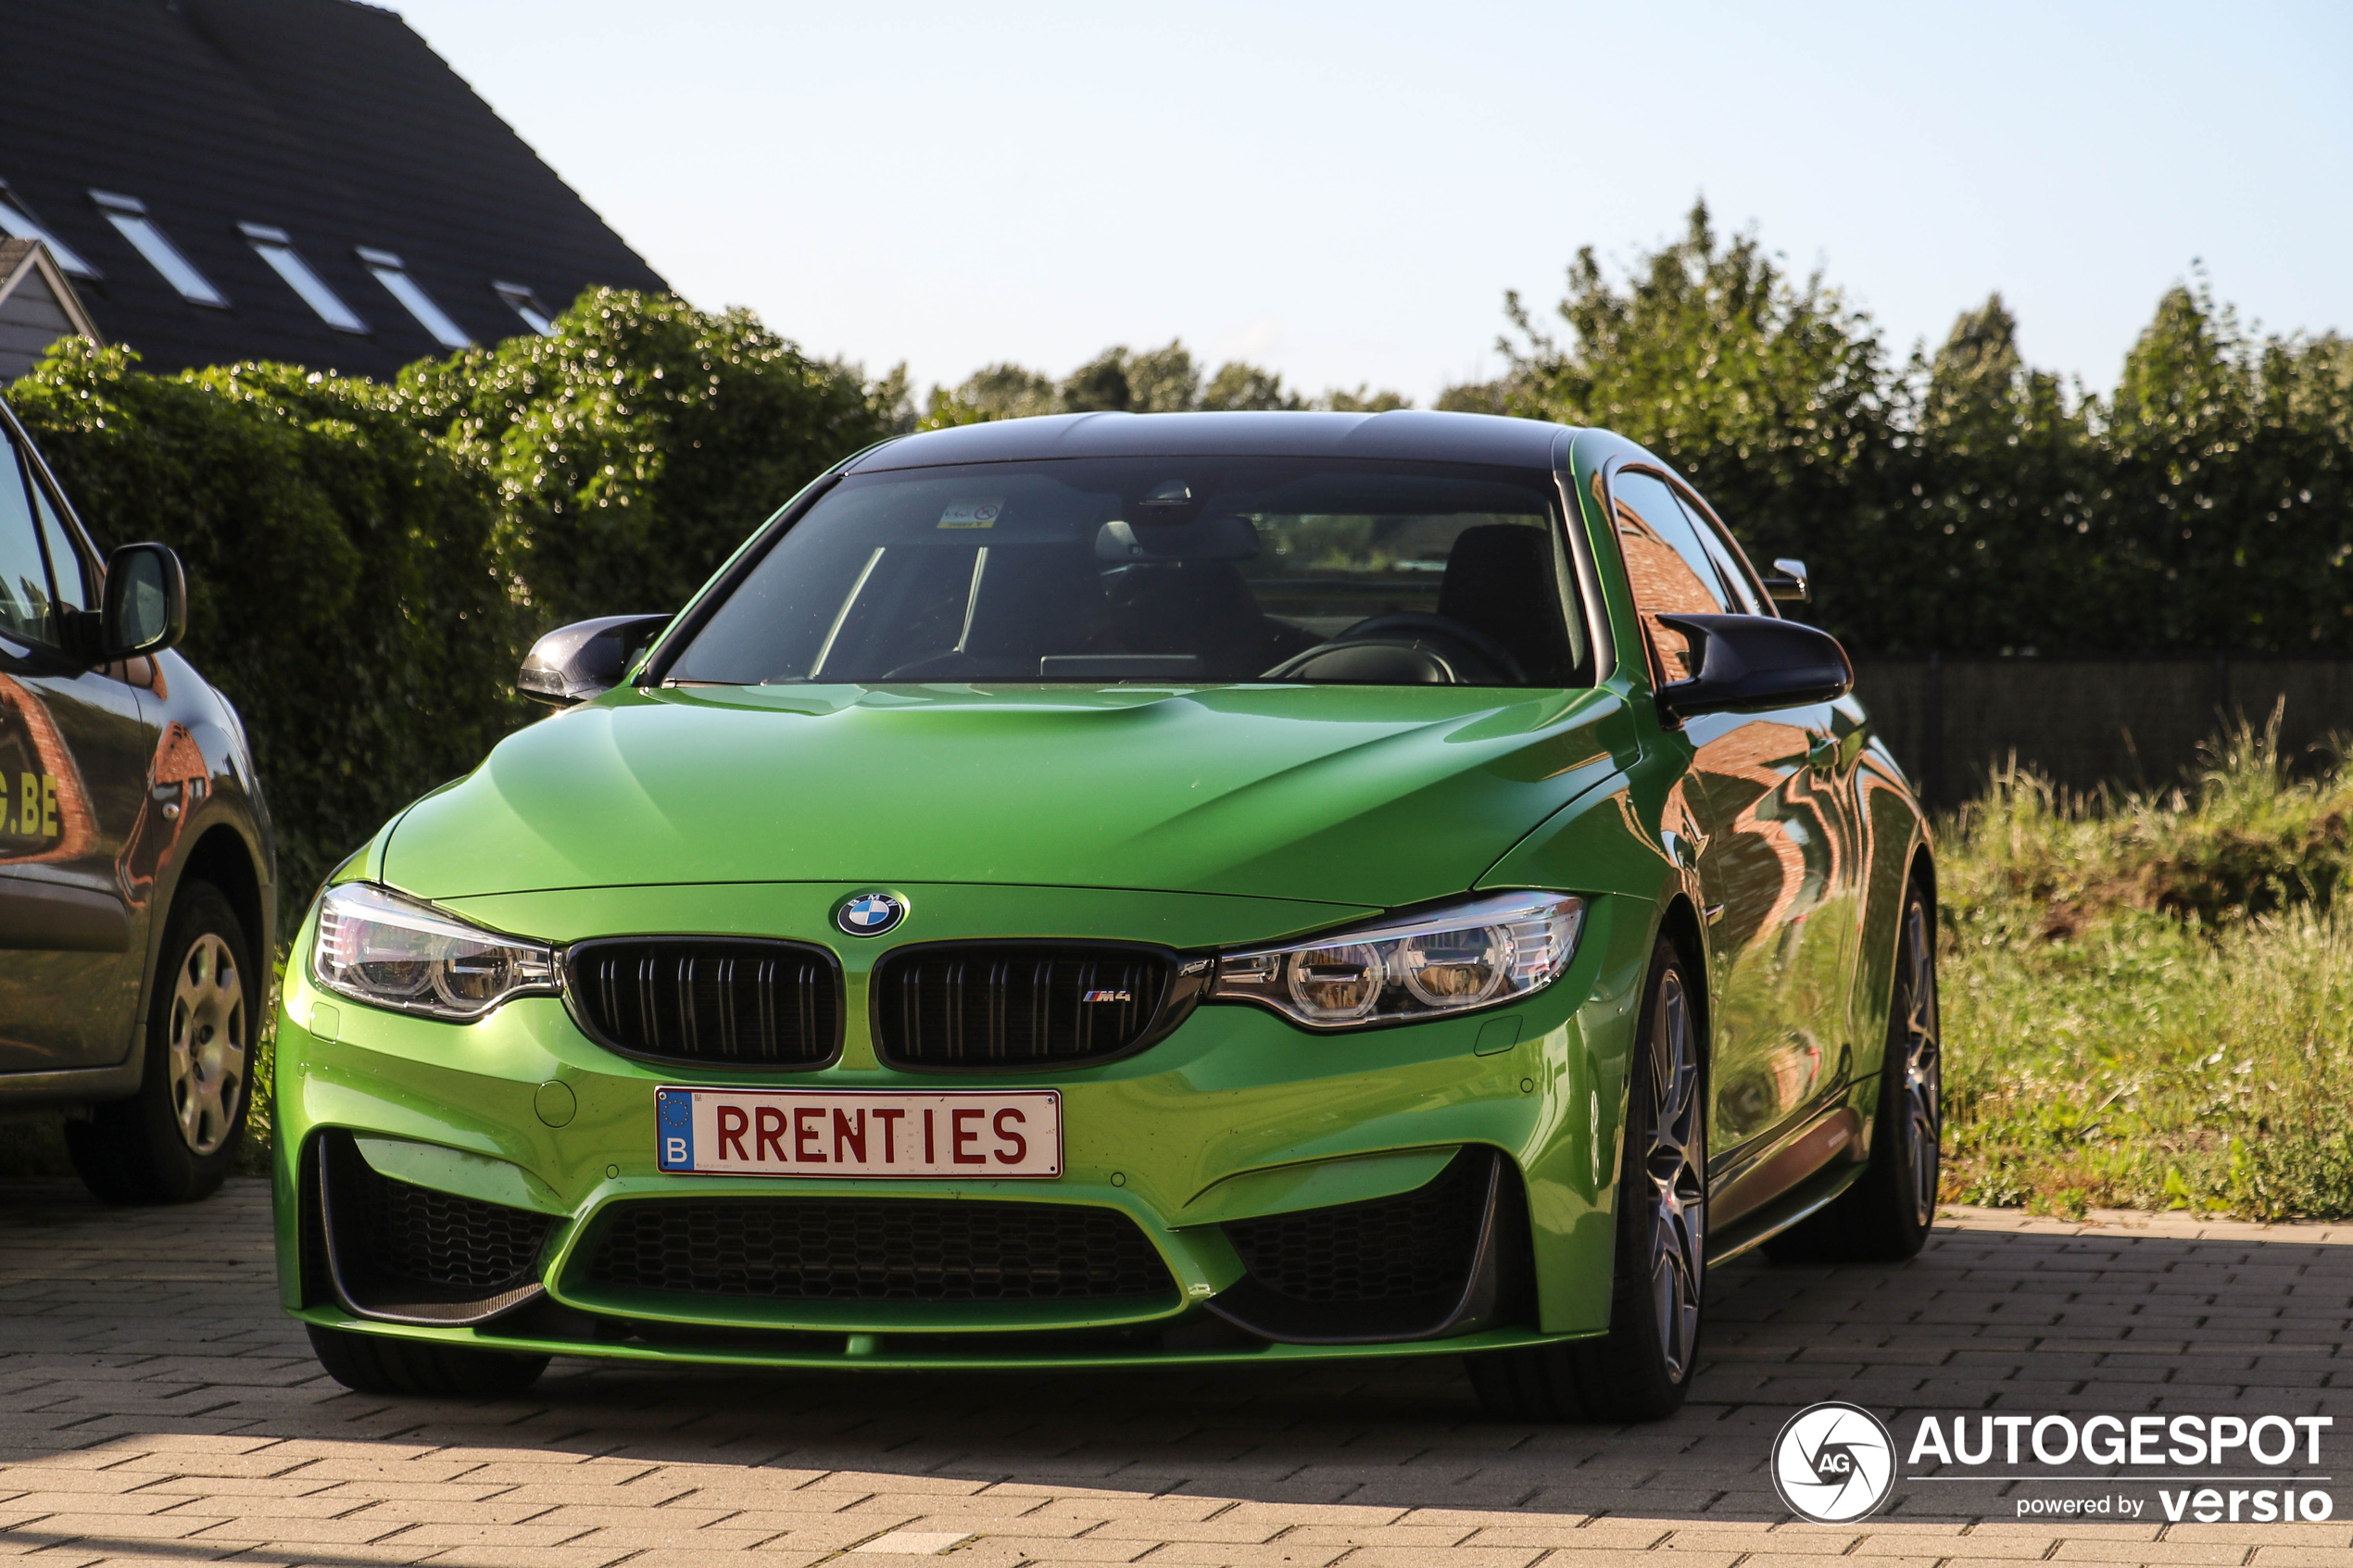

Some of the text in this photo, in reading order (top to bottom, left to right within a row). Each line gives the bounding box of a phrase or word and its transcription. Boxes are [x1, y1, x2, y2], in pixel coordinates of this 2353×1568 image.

[848, 894, 899, 907] BMW
[1096, 990, 1131, 1002] M4
[716, 1105, 1027, 1165] RRENTIES
[667, 1137, 687, 1163] B
